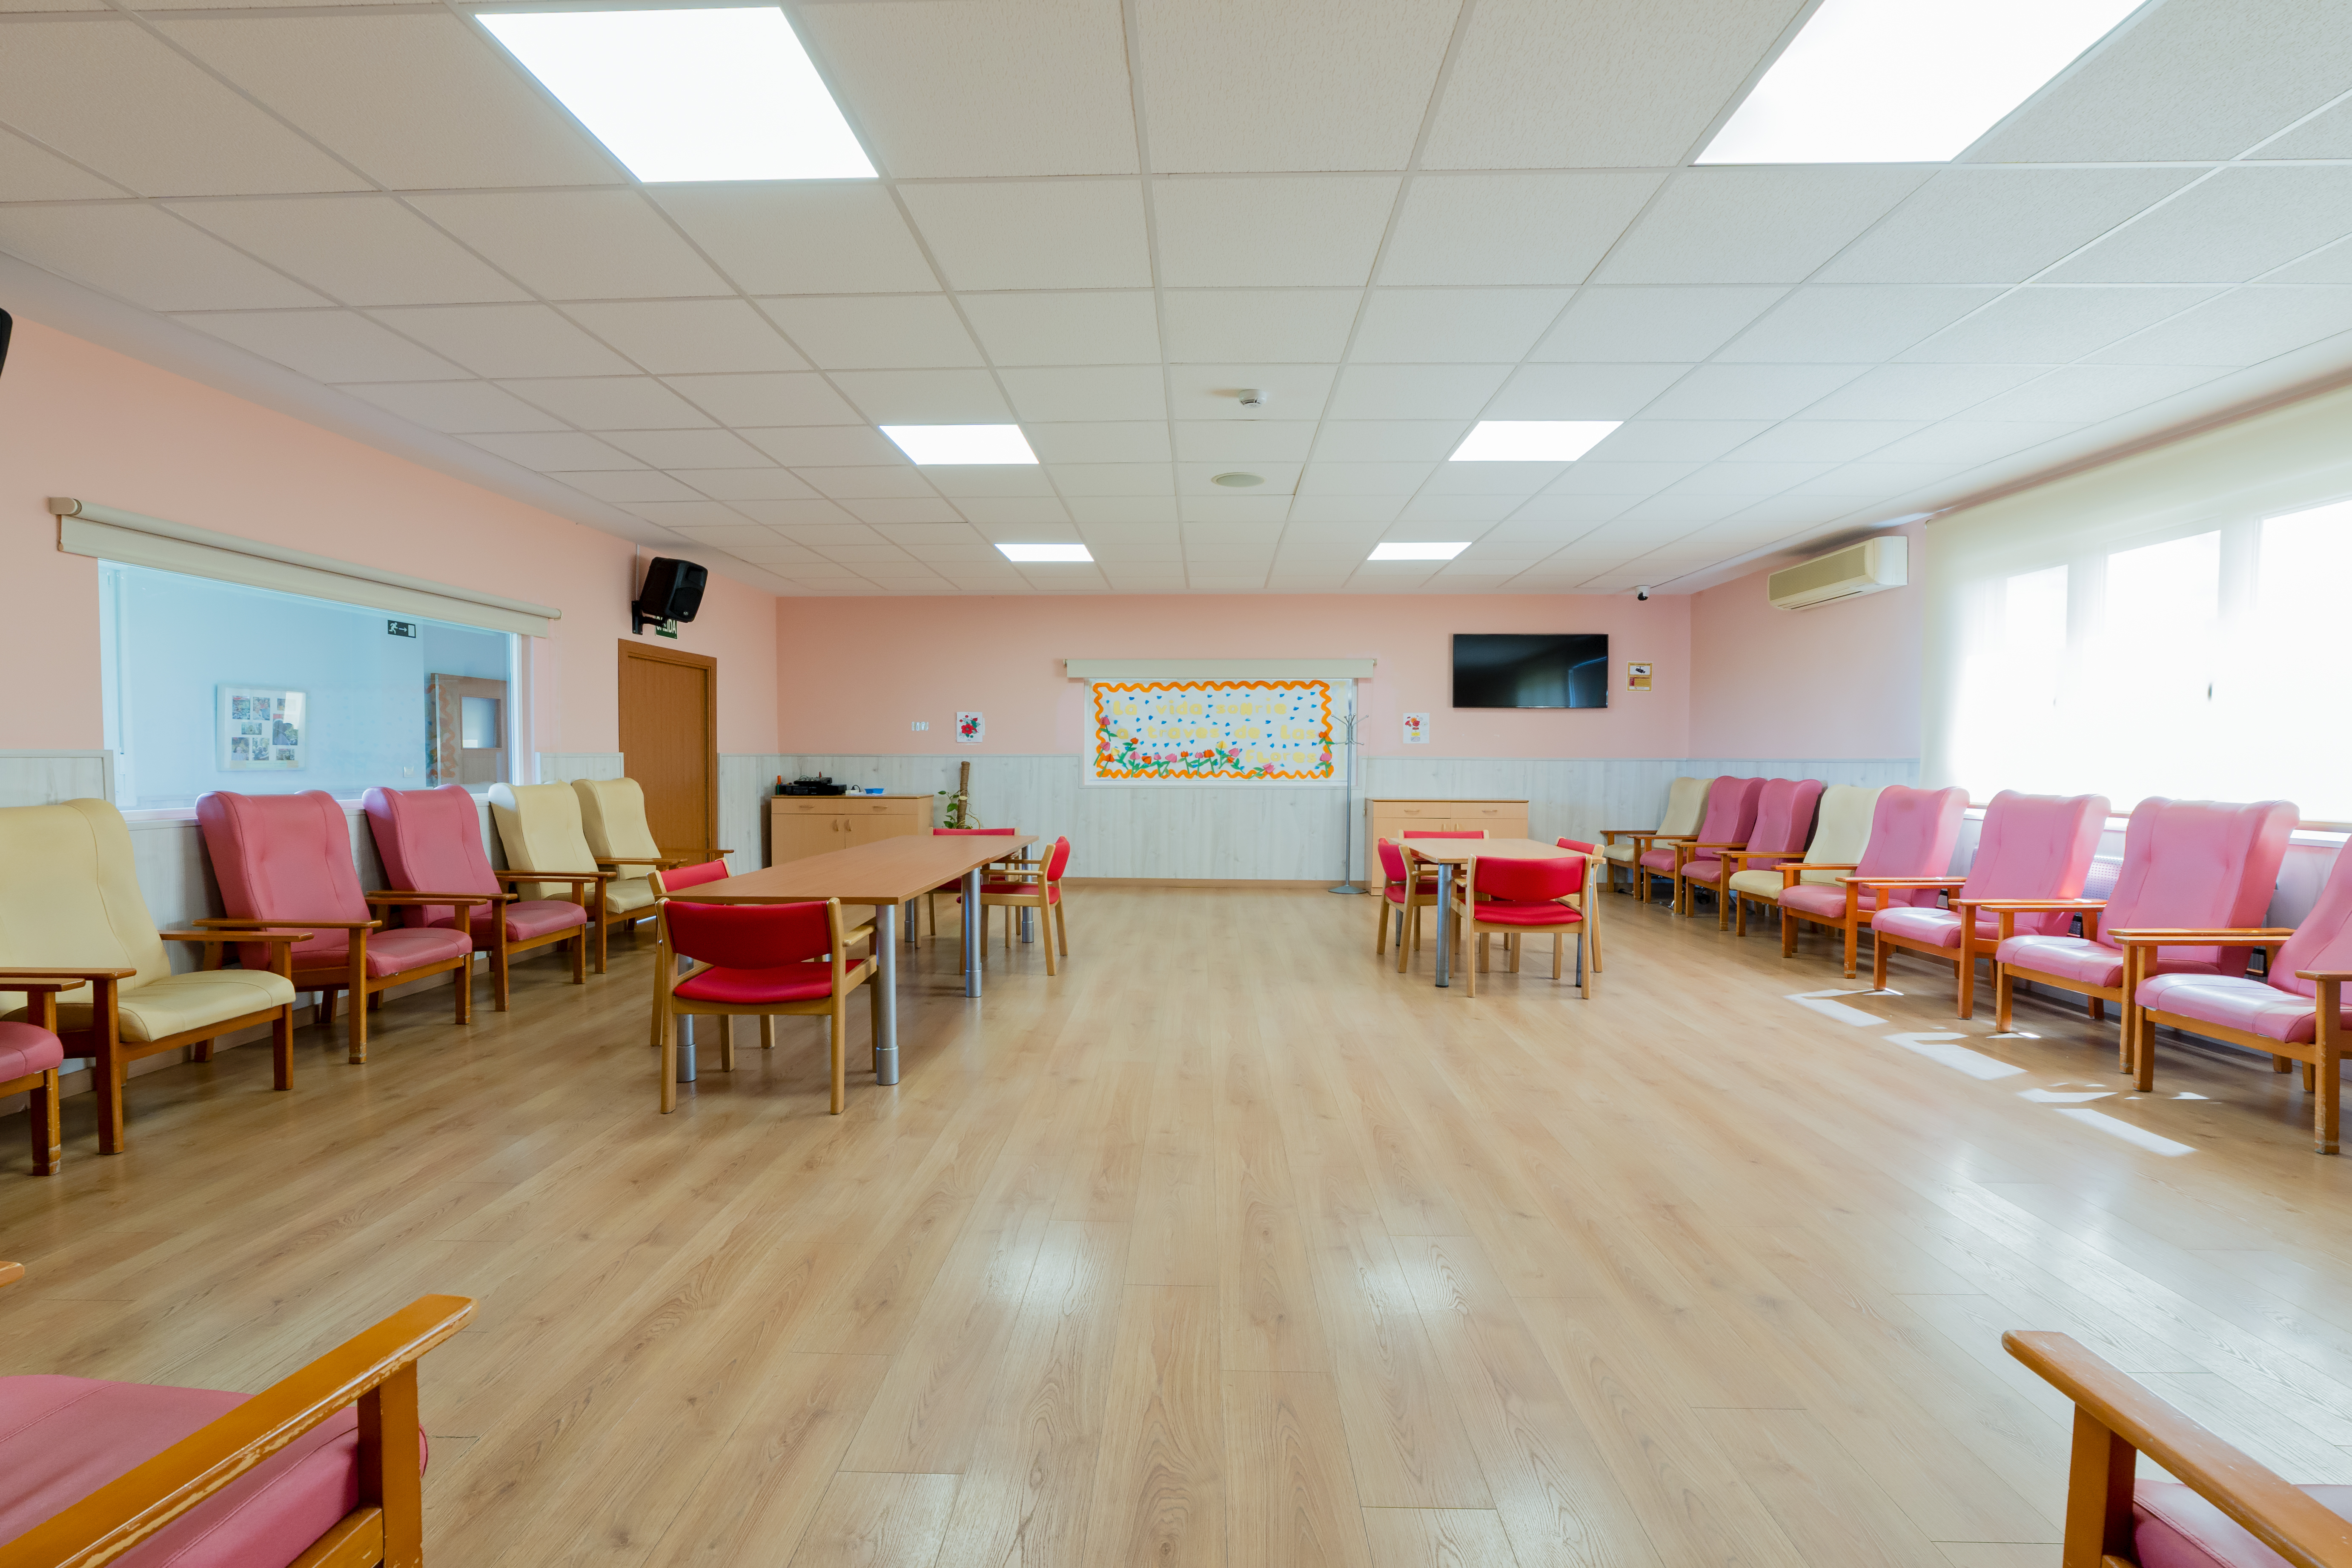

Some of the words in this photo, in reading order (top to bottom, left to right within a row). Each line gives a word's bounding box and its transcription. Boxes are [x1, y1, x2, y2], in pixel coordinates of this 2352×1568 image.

[1156, 699, 1203, 715] vida
[1116, 728, 1129, 740] a
[1147, 725, 1220, 739] traves
[1234, 725, 1261, 739] de
